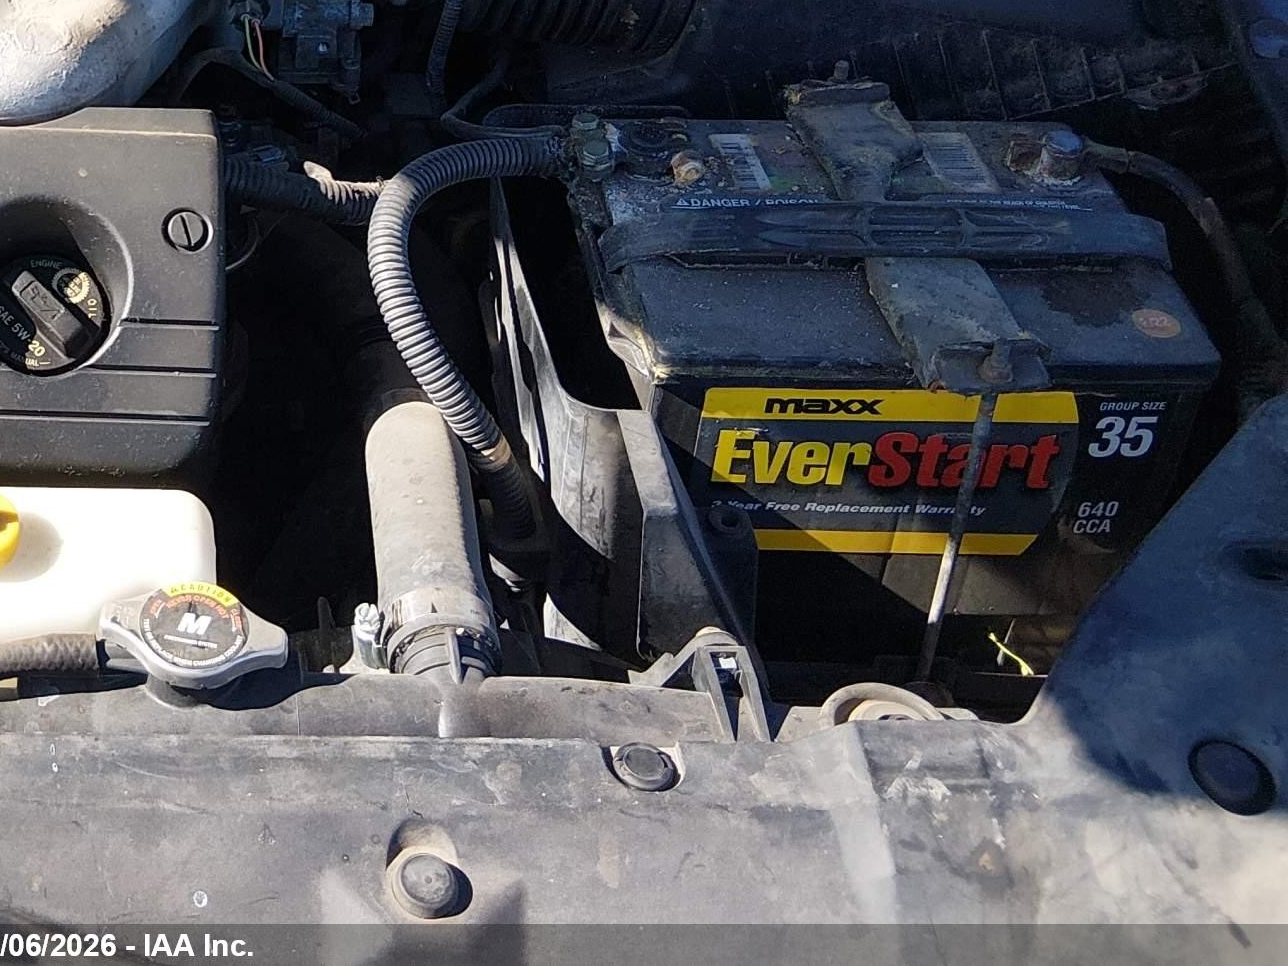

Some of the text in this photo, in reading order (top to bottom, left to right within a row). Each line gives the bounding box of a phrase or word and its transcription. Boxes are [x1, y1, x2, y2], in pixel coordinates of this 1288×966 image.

[690, 198, 749, 209] DANGER
[30, 259, 62, 270] ENGINE
[87, 298, 98, 319] OIL
[12, 322, 46, 357] 5W-20
[764, 398, 883, 416] maxx
[1099, 401, 1168, 411] GROUP SIZE
[1088, 416, 1159, 458] 35
[711, 429, 1059, 490] EverStart
[765, 501, 800, 512] Free
[804, 501, 911, 515] Replacement
[914, 503, 987, 516] Warraty
[1078, 501, 1119, 518] 640
[1073, 518, 1111, 534] CCA
[176, 612, 212, 636] M
